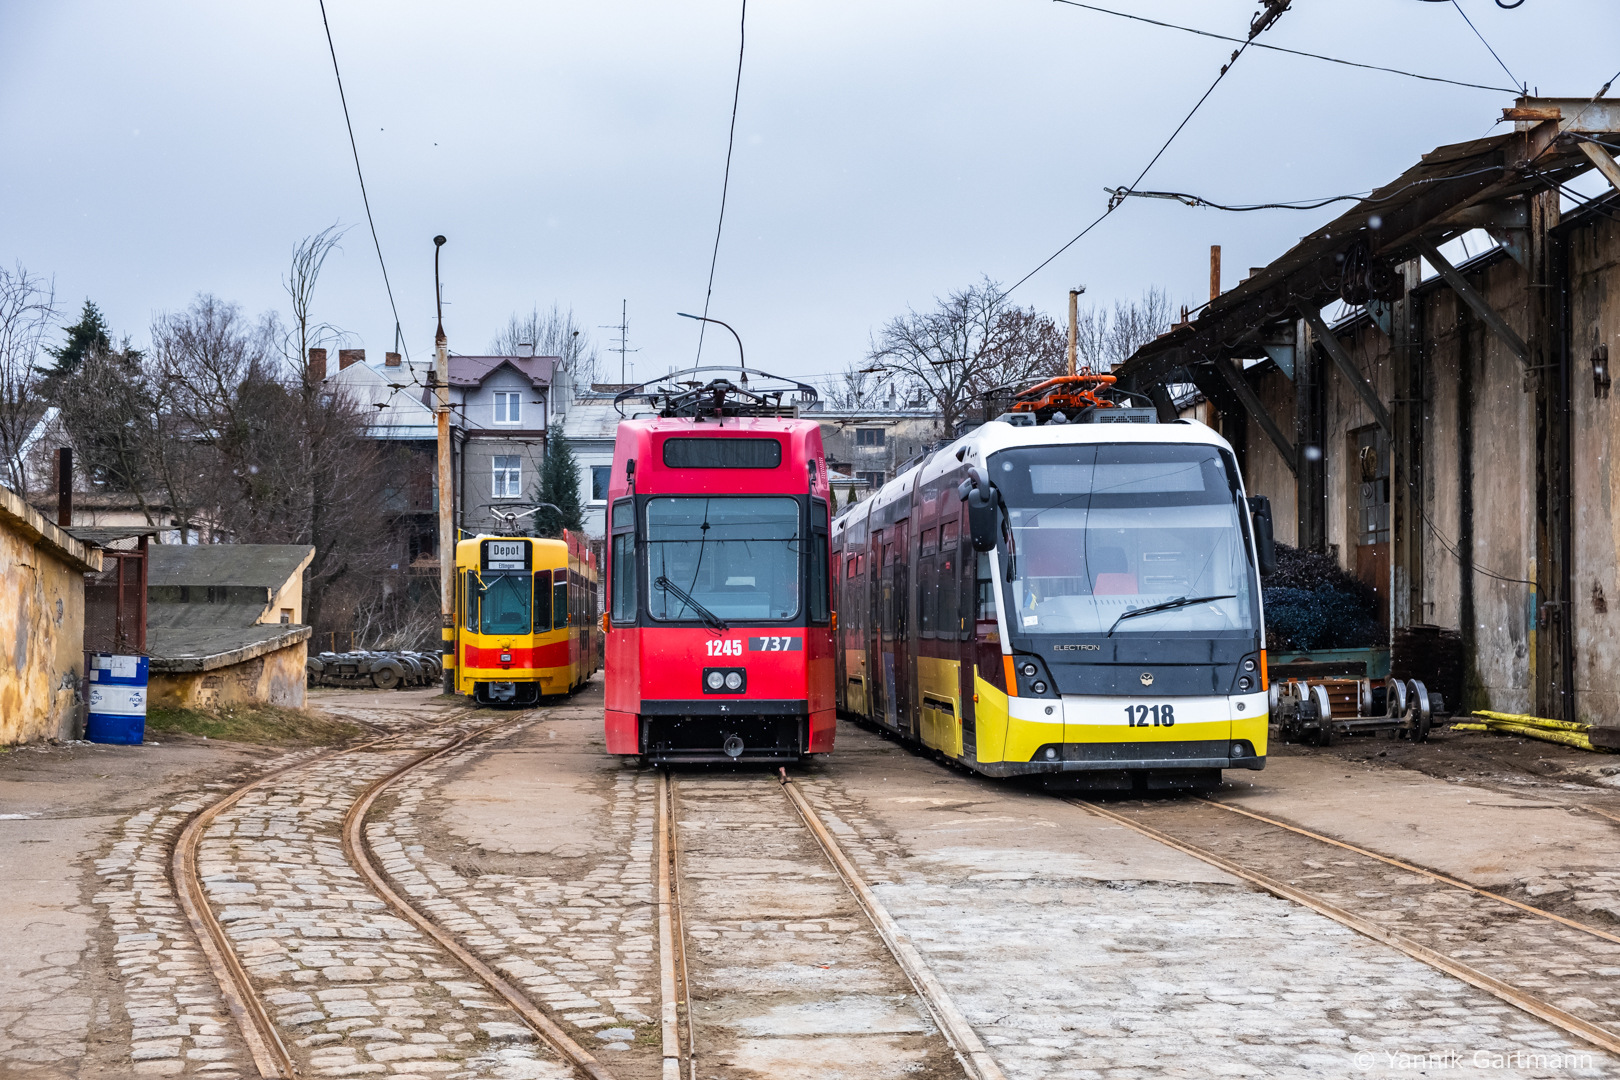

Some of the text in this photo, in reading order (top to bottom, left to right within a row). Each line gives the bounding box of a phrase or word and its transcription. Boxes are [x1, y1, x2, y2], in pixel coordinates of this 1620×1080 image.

[493, 544, 519, 556] Depot
[705, 639, 743, 656] 1245
[759, 636, 792, 652] 737
[1124, 704, 1175, 728] 1218
